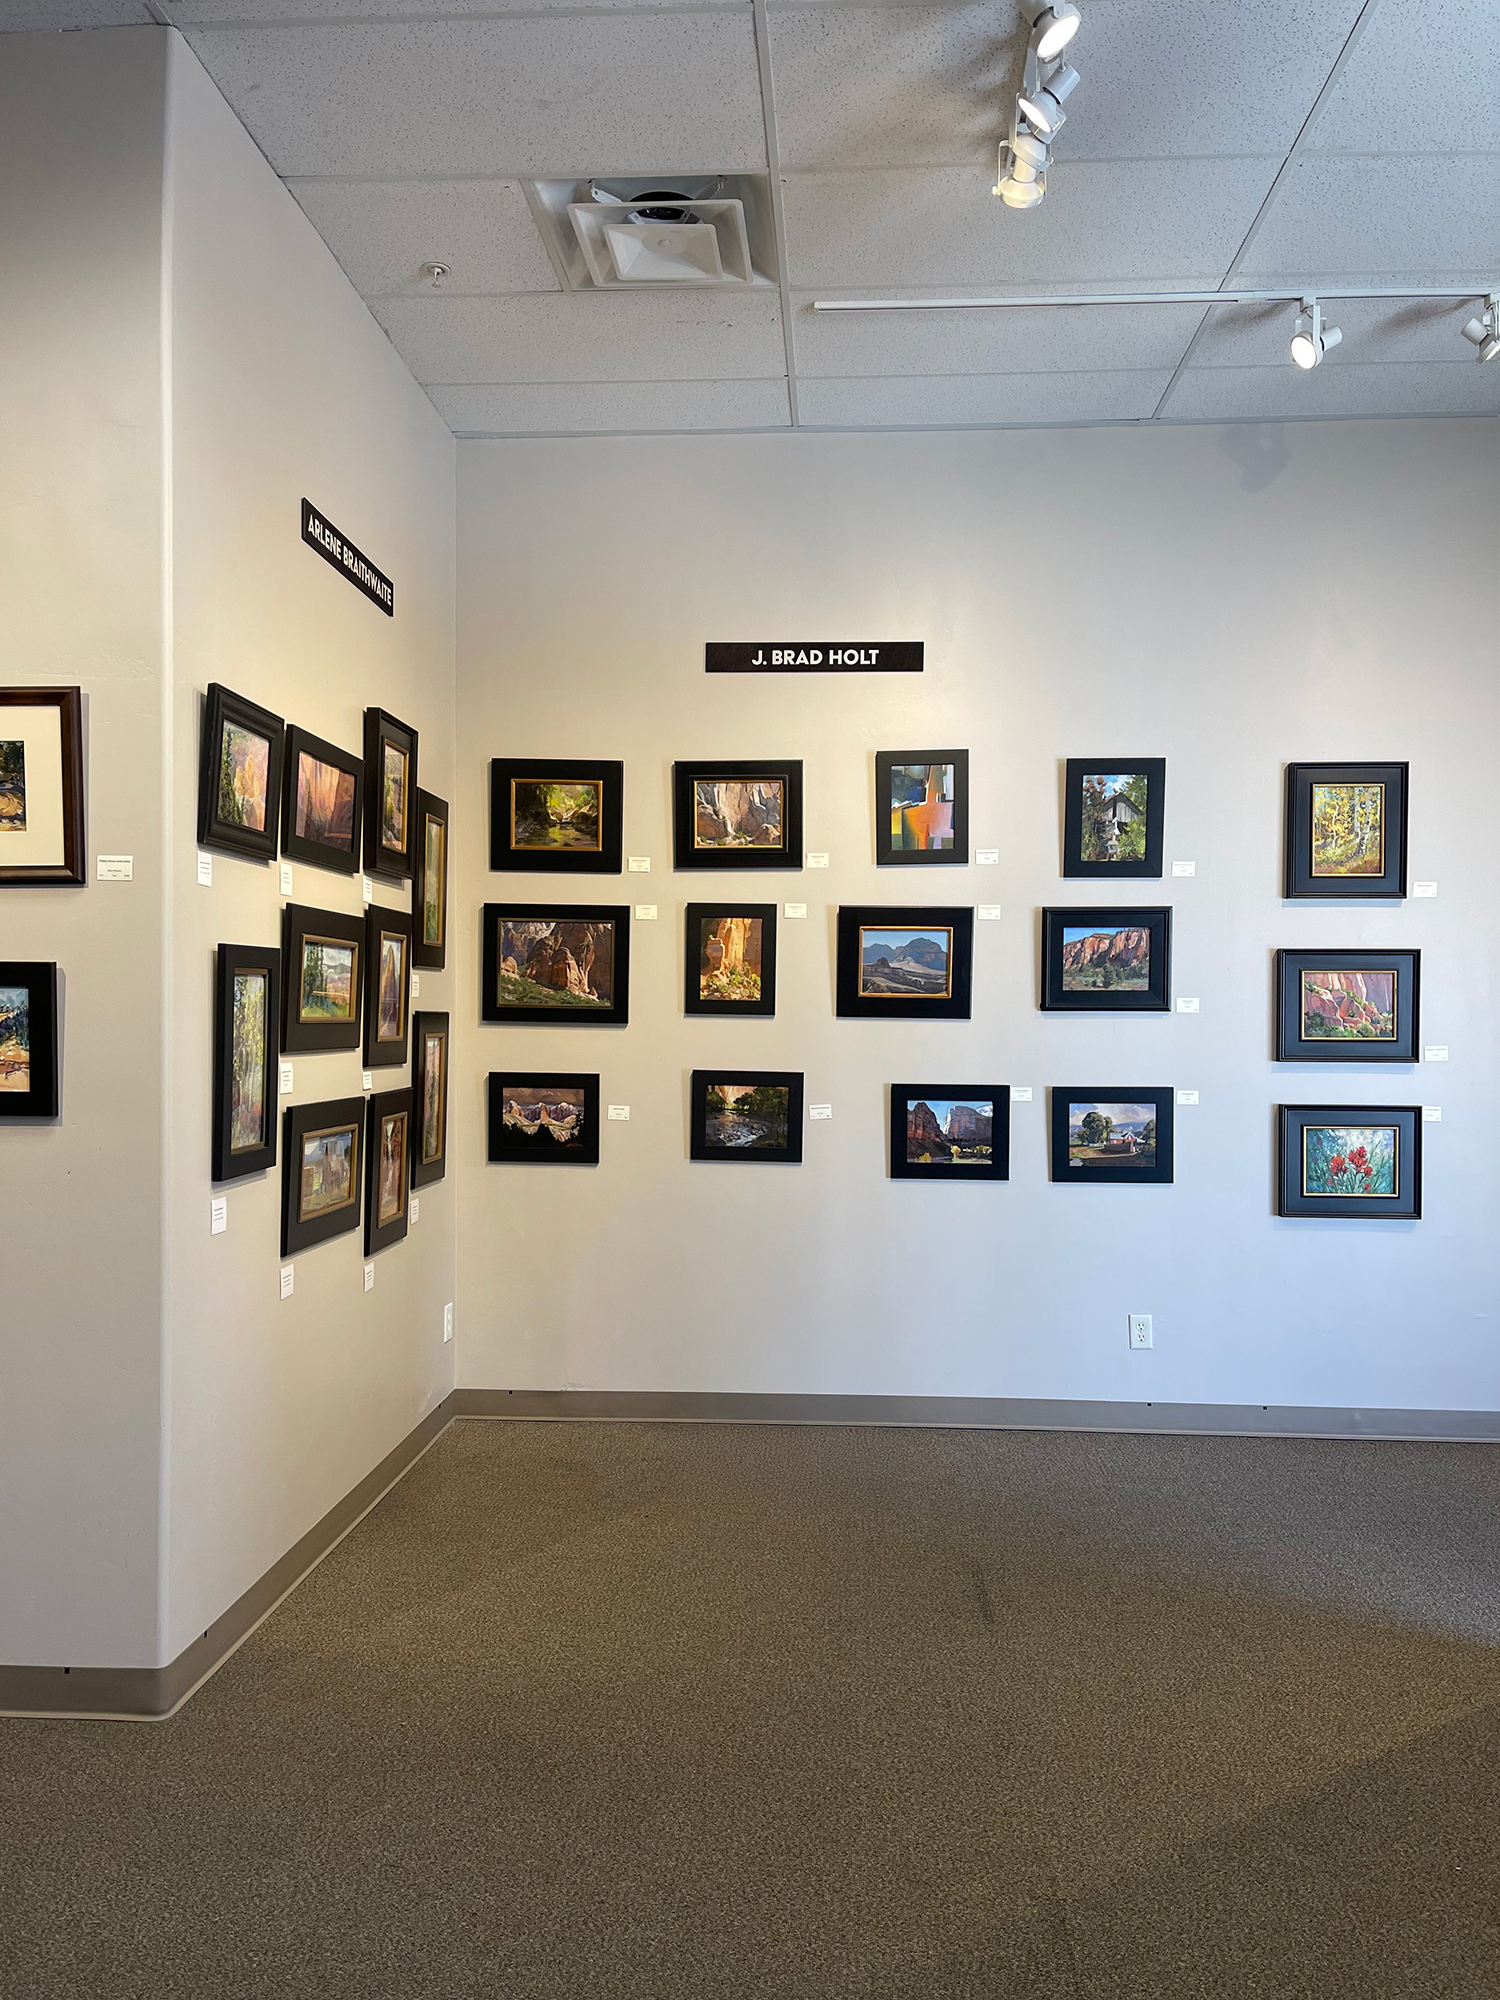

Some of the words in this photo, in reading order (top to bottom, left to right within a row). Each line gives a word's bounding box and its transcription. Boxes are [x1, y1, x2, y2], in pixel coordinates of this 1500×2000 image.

[308, 514, 342, 560] ARLENE
[343, 545, 392, 606] BRAITHWAITE
[751, 650, 767, 666] J.
[772, 650, 823, 665] BRAD
[829, 649, 879, 665] HOLT
